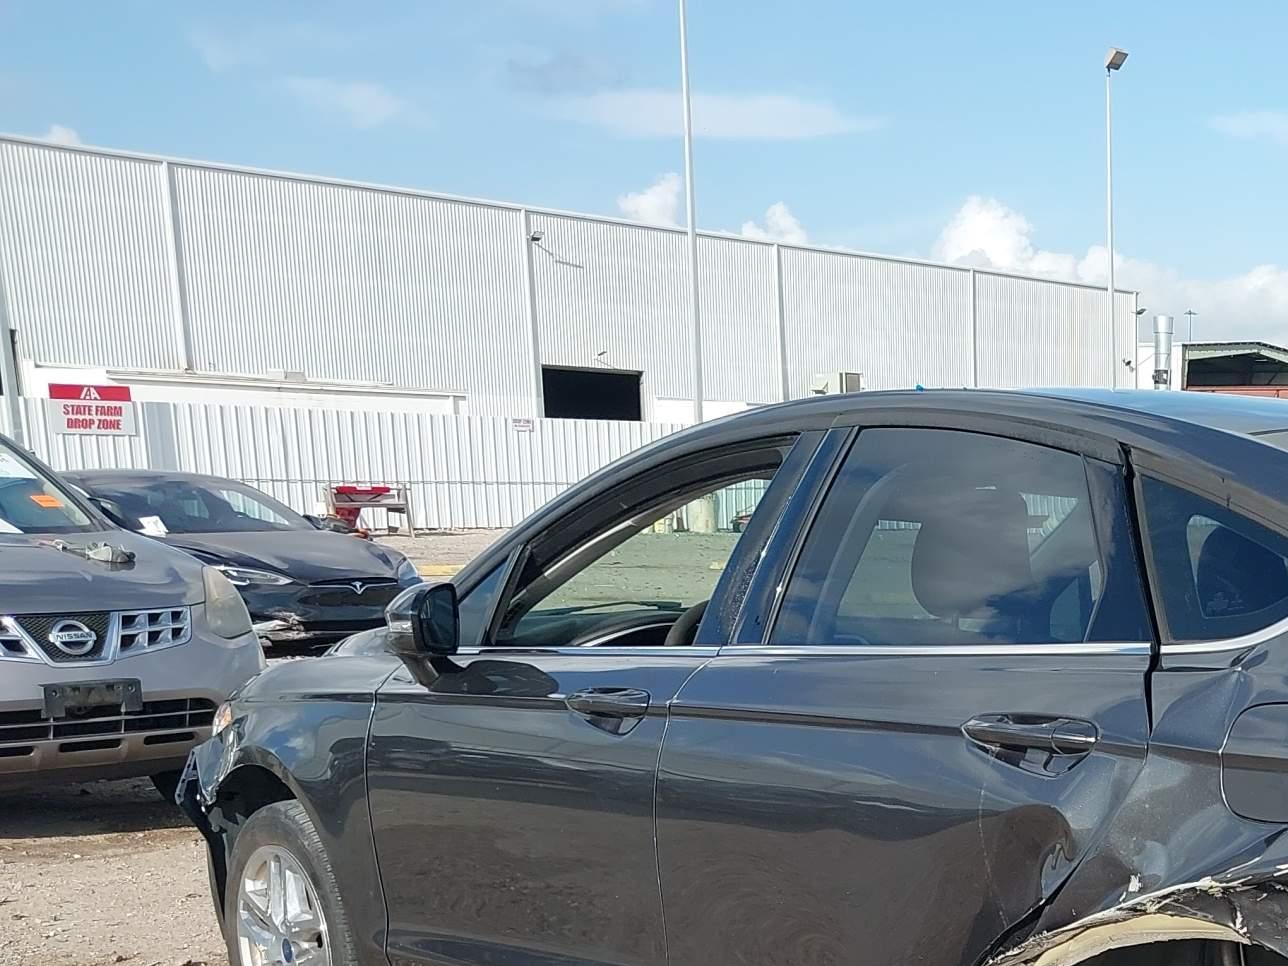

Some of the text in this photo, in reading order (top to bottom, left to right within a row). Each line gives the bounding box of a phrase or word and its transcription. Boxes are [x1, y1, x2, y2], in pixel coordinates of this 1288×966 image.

[63, 404, 123, 417] STATE FARM
[66, 418, 122, 430] DROP ZONE
[56, 632, 93, 640] NISSAN
